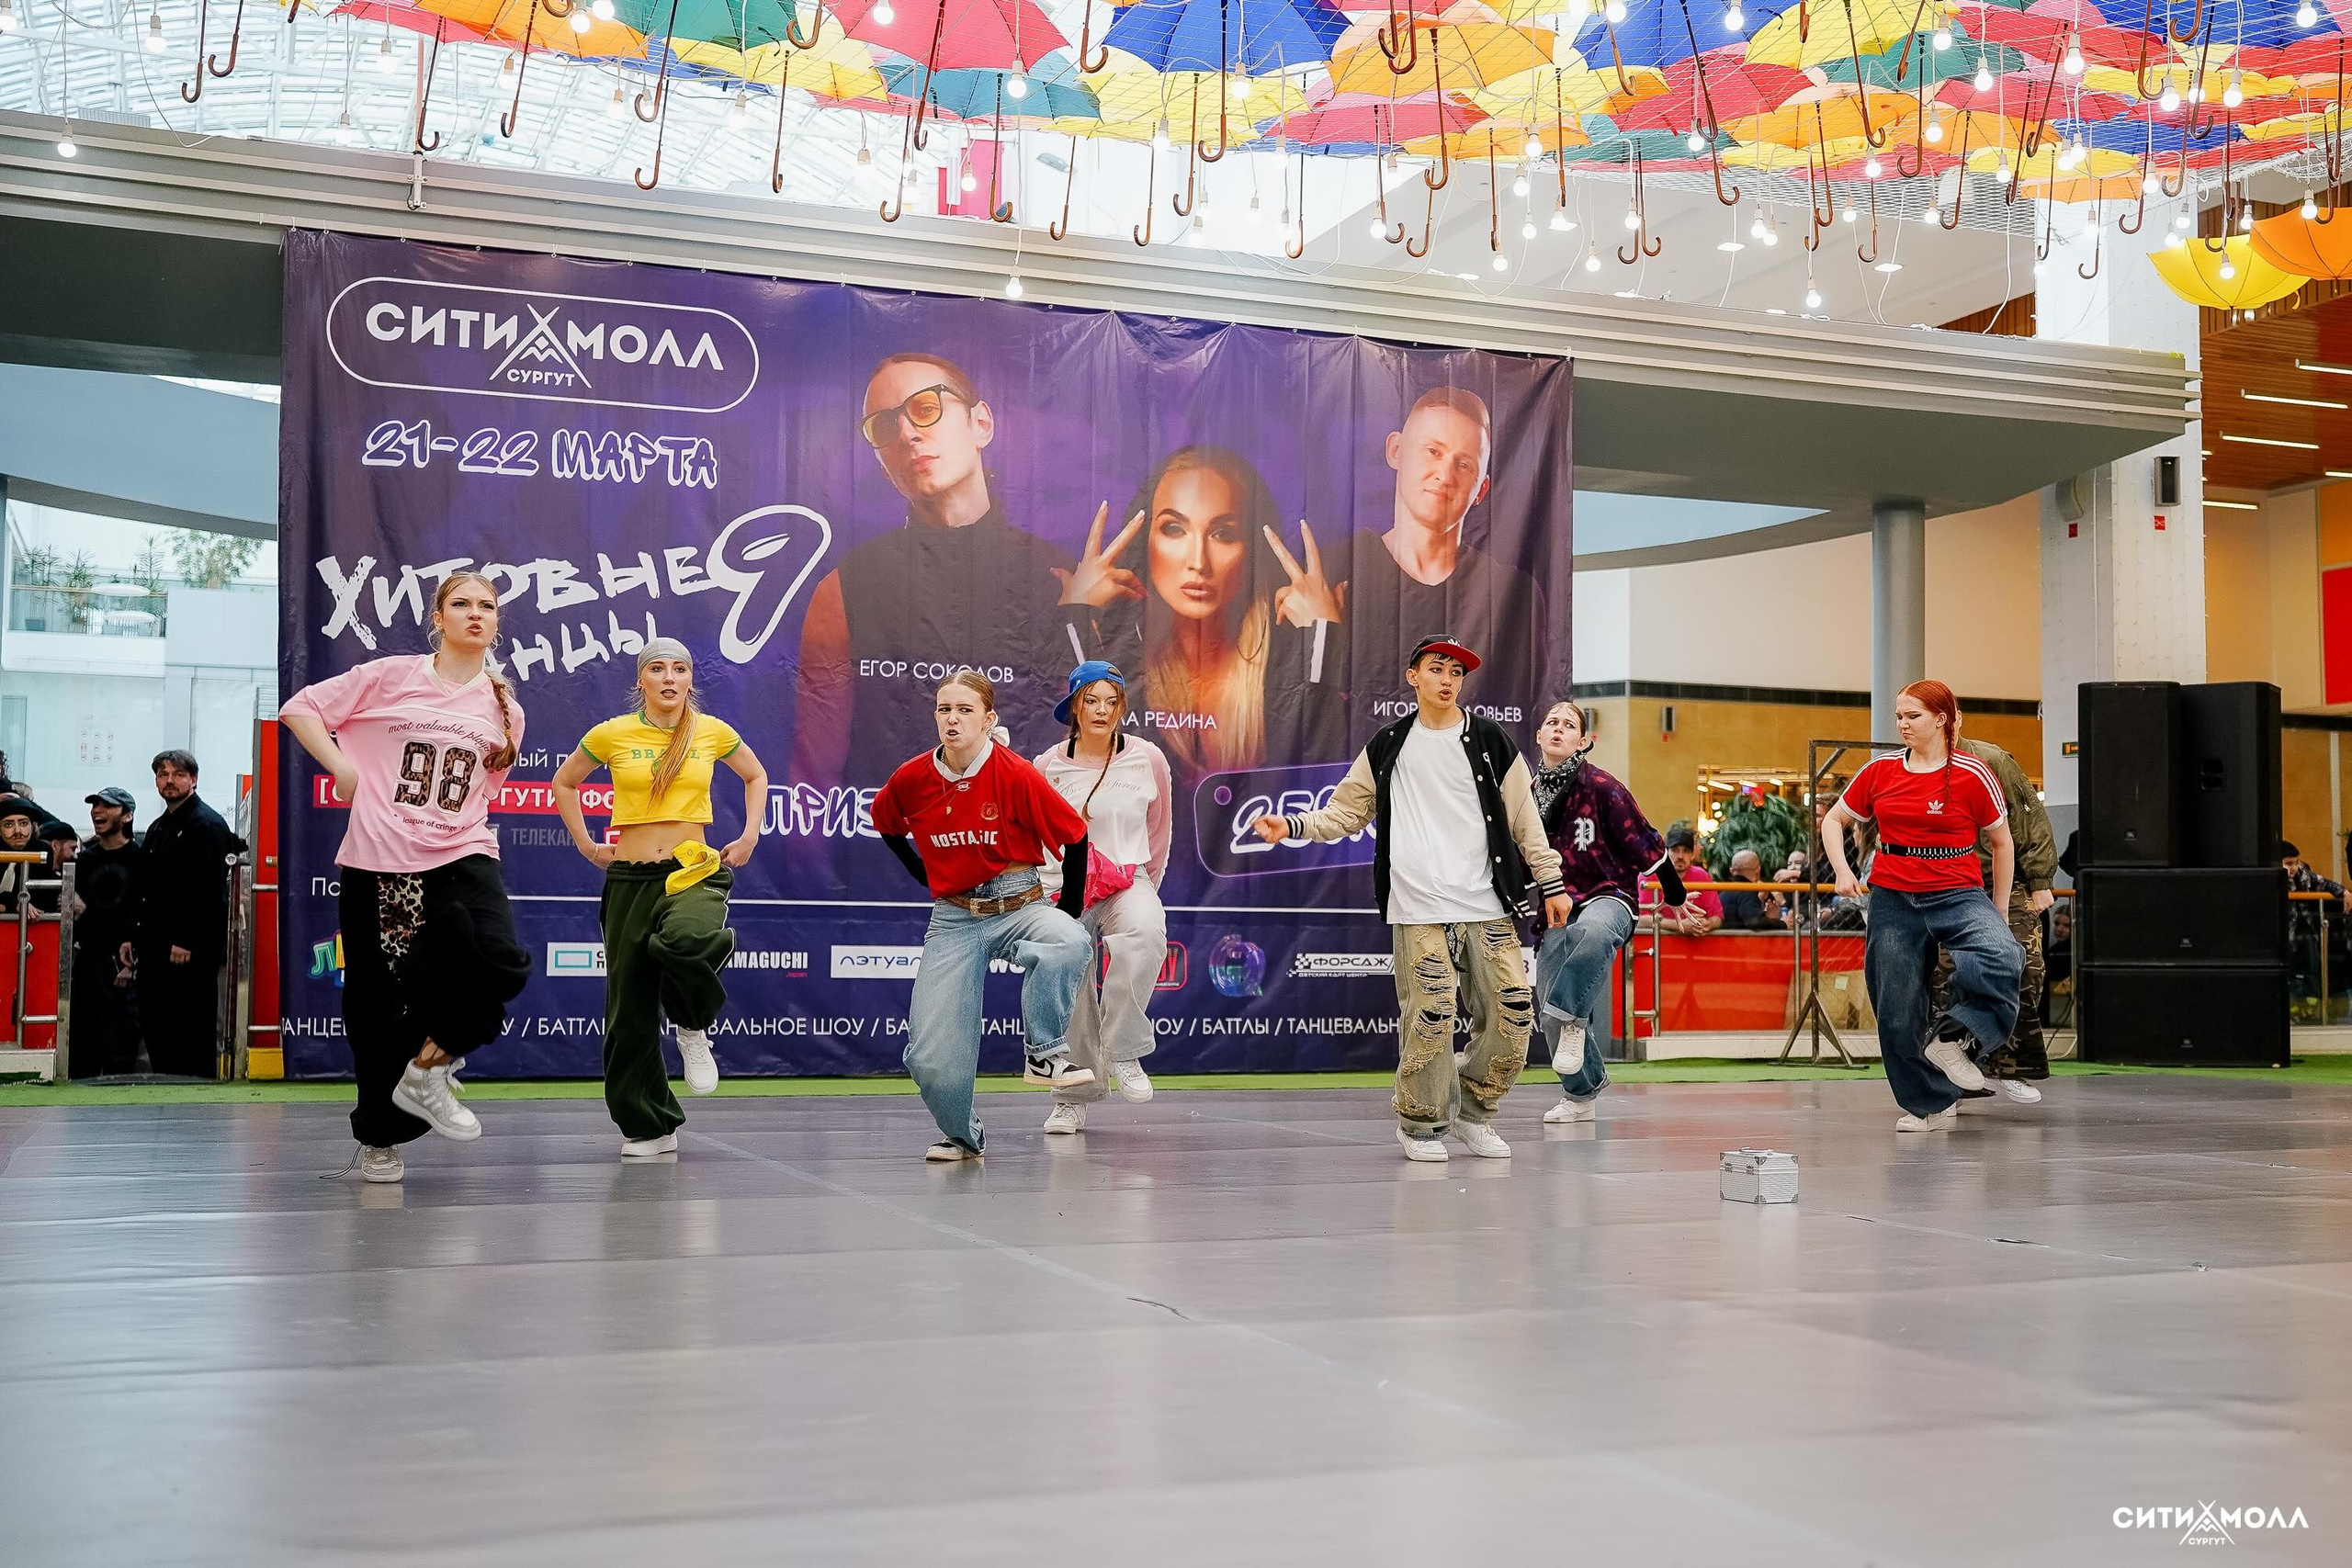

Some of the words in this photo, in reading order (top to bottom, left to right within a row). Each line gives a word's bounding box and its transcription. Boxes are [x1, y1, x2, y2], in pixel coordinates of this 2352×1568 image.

[365, 301, 521, 349] СИТИ
[567, 319, 725, 372] МОЛЛ
[506, 367, 577, 388] СУРГУТ
[361, 419, 540, 477] 21-22
[551, 428, 719, 490] МАРТА
[860, 659, 908, 678] ЕГОР
[1374, 700, 1419, 718] ИГОР
[388, 721, 415, 735] most
[415, 719, 466, 737] valuable
[1144, 710, 1218, 730] РЕДИНА
[393, 739, 478, 815] 98
[402, 816, 425, 827] league
[425, 820, 435, 829] of
[435, 821, 458, 833] cringe
[1313, 957, 1388, 967] ФОРСАЖ
[812, 1017, 865, 1036] ШОУ
[1202, 1017, 1270, 1036] БАТТЛЫ
[1287, 1017, 1399, 1036] ТАНЦЕВАЛЬН
